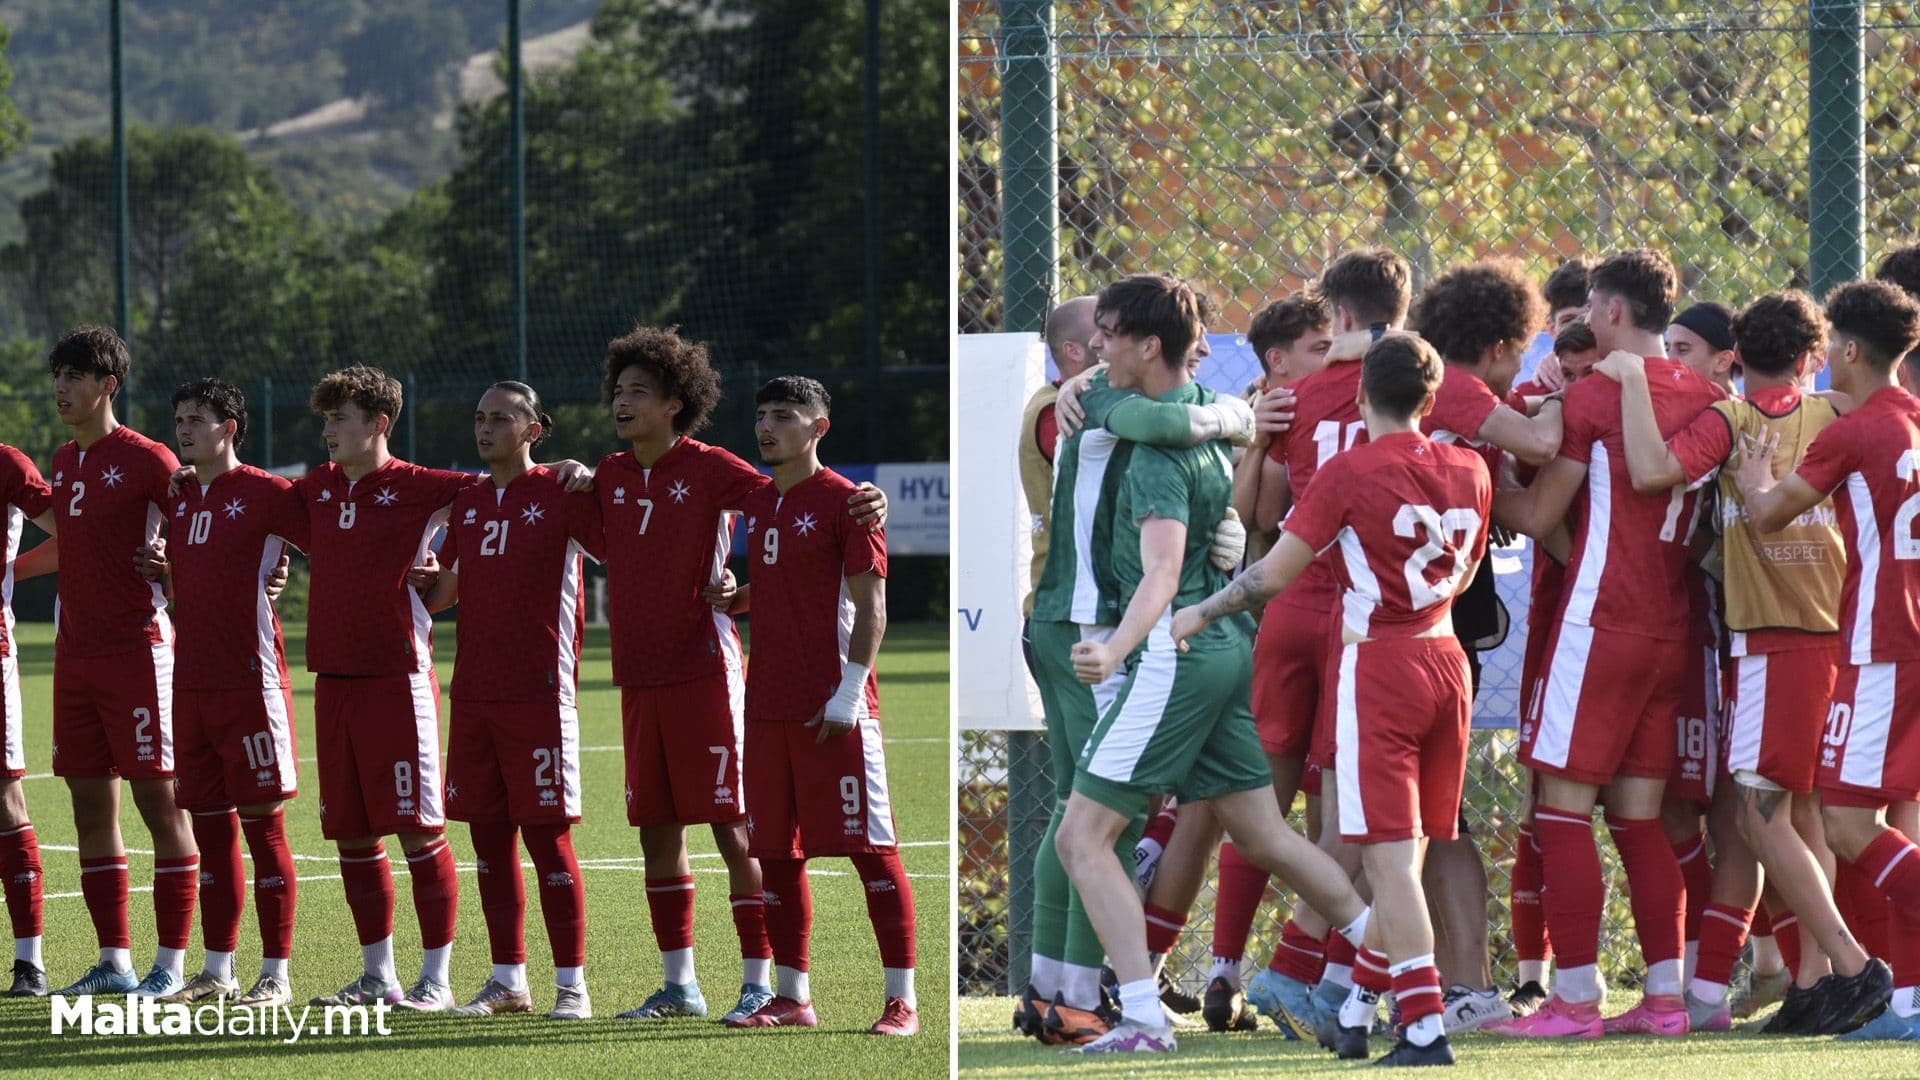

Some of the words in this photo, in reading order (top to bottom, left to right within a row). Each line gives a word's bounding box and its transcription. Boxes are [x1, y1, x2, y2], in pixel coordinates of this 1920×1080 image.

[69, 481, 86, 517] 2
[338, 501, 356, 530] 8
[636, 499, 654, 535] 7
[187, 510, 213, 546] 10
[480, 519, 509, 556] 21
[763, 527, 779, 565] 9
[1763, 543, 1825, 561] RESPECT
[132, 707, 153, 743] 2
[1676, 716, 1706, 759] 18
[242, 730, 276, 770] 10
[532, 747, 562, 787] 21
[709, 746, 730, 785] 7
[394, 760, 413, 797] 8
[839, 775, 860, 815] 9
